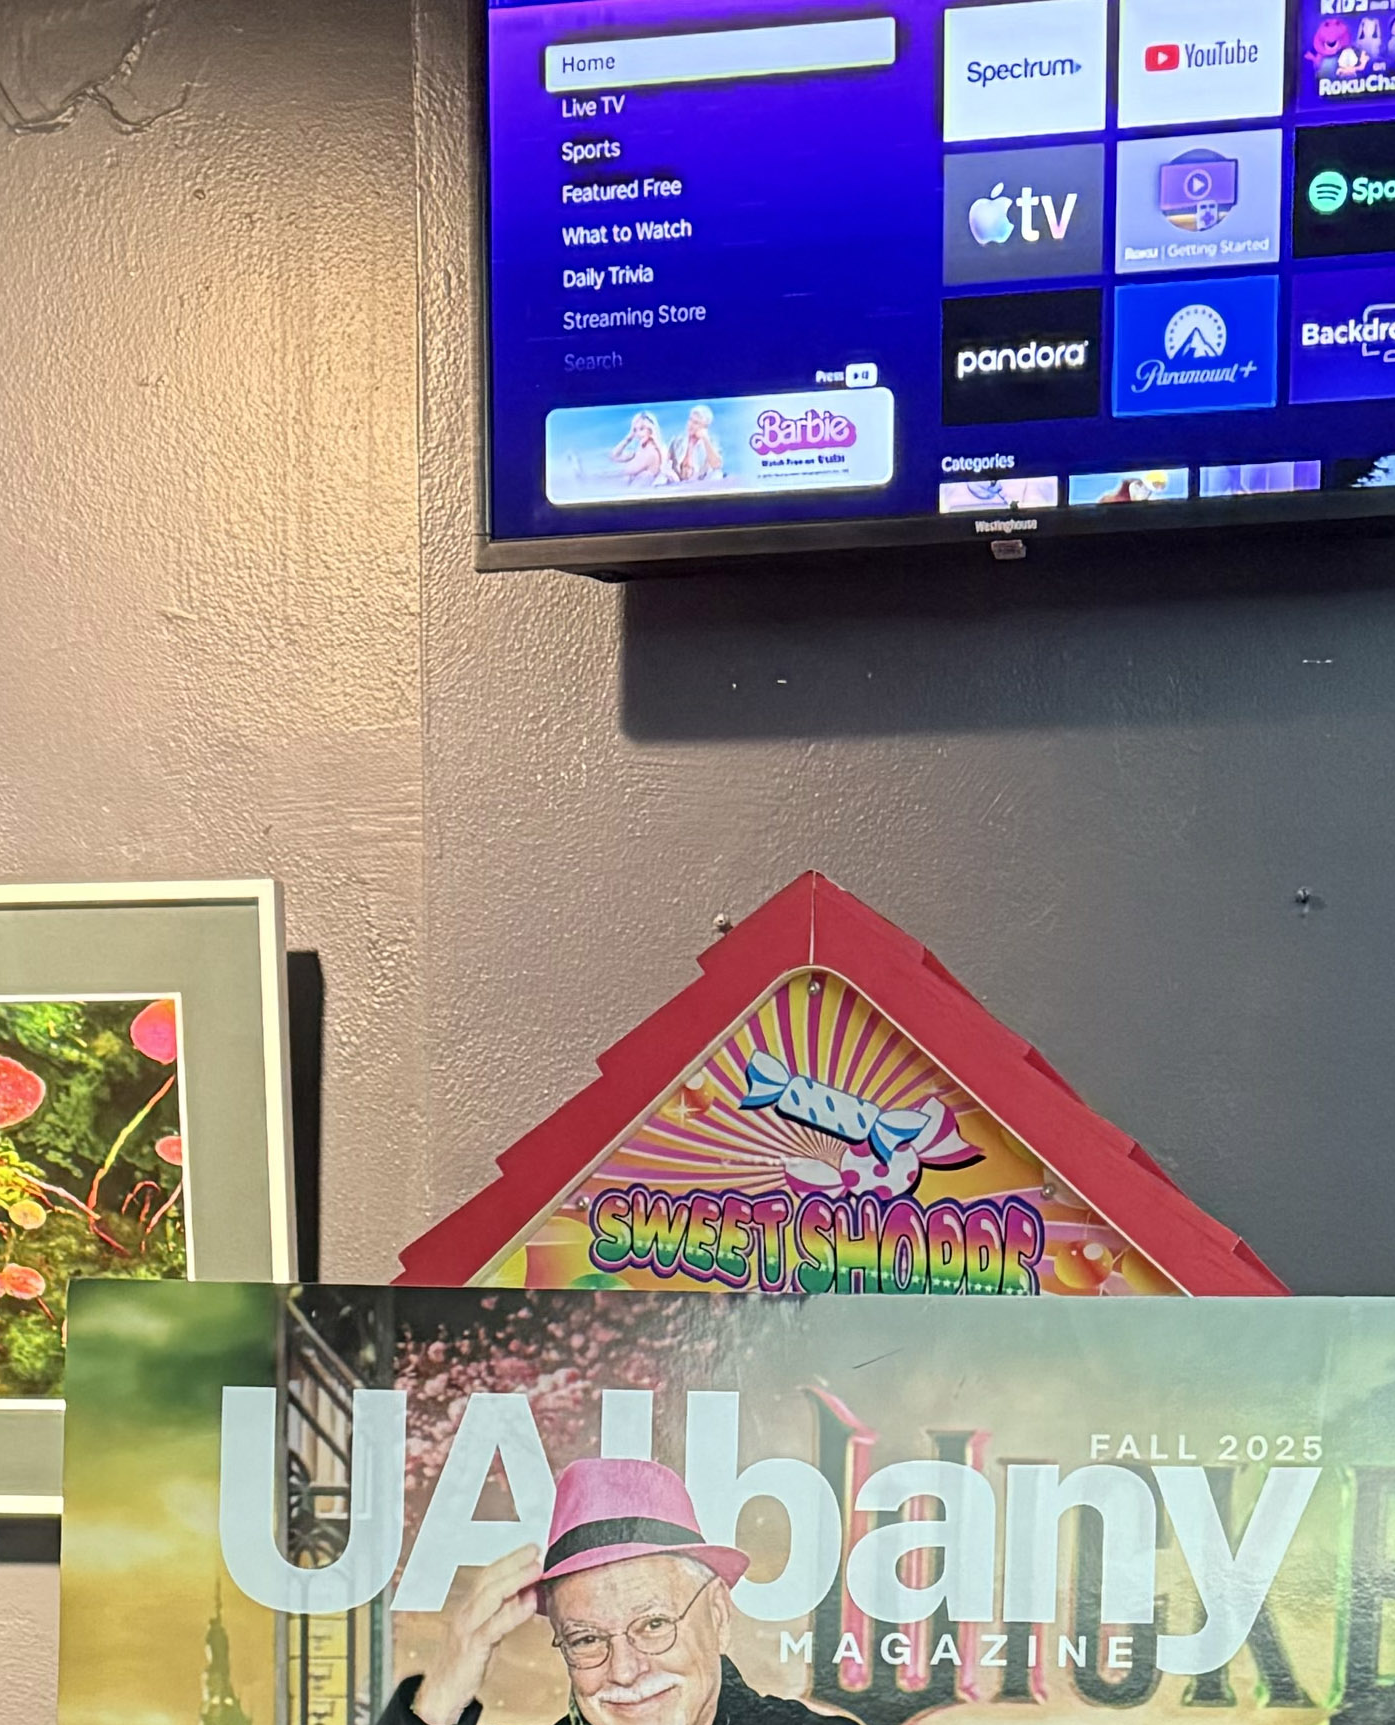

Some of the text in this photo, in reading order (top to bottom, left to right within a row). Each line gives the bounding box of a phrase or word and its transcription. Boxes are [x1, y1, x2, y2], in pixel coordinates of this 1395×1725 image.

[562, 54, 615, 74] Home
[1185, 38, 1258, 68] YouTube
[967, 57, 1074, 88] Spectrum
[561, 96, 626, 119] Live TV
[561, 140, 621, 164] Sports
[562, 178, 682, 204] Featured Free
[562, 219, 692, 247] What to Watch
[1167, 244, 1217, 257] Getting
[1220, 238, 1270, 253] Started
[563, 265, 654, 291] Daily Trivia
[563, 304, 706, 331] Streaming Store
[564, 352, 623, 373] Search
[958, 341, 1087, 380] pandora
[1131, 359, 1257, 393] Paramount+
[750, 409, 856, 455] Barbie
[941, 453, 1015, 473] Categories
[590, 1184, 792, 1292] SWEET
[1091, 1433, 1323, 1462] FALL 2025
[778, 1630, 1134, 1670] MAGAZINE
